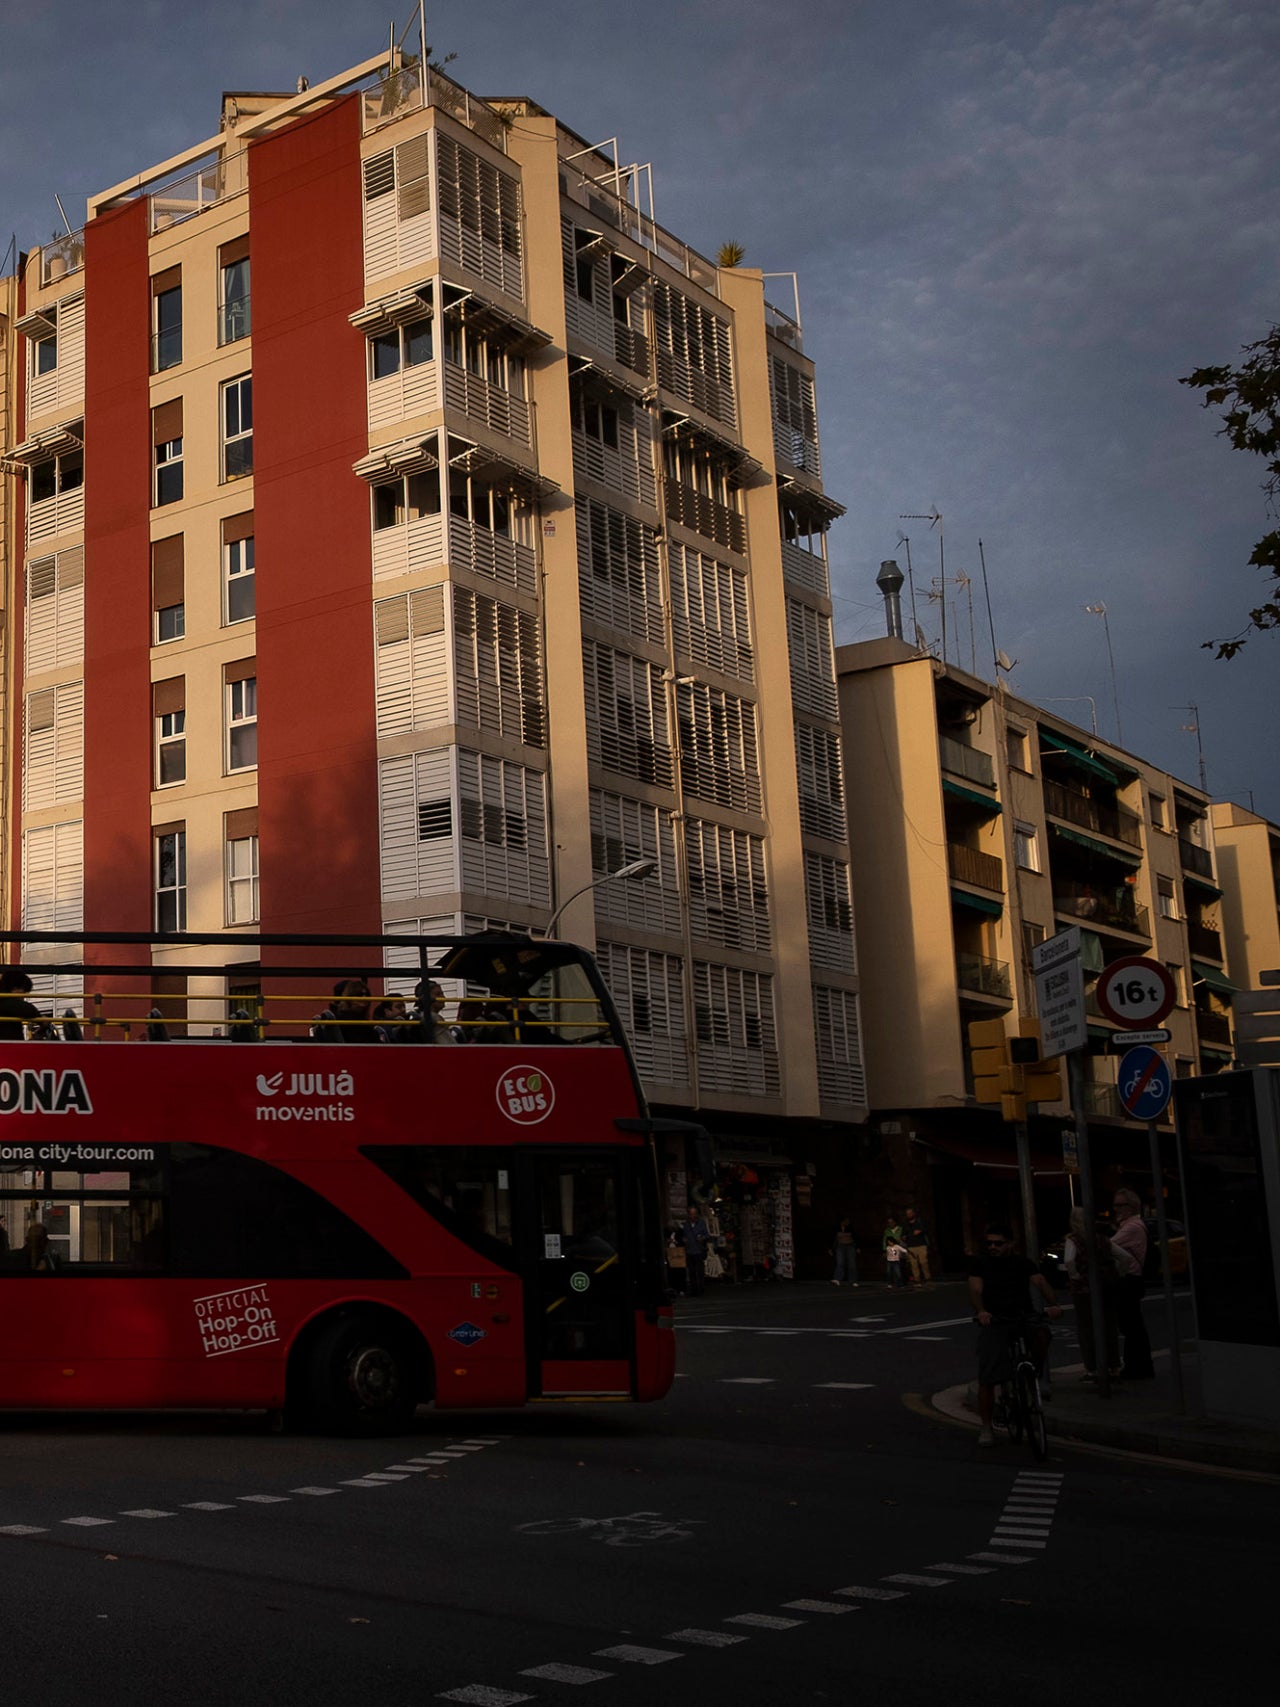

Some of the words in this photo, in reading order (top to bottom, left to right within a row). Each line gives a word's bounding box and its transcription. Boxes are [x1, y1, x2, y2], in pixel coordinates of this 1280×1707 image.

[256, 1102, 355, 1121] moventis
[507, 1093, 547, 1115] BUS
[194, 1288, 270, 1317] OFFICIAL
[198, 1306, 272, 1335] Hop-On
[202, 1320, 277, 1352] Hop-Off
